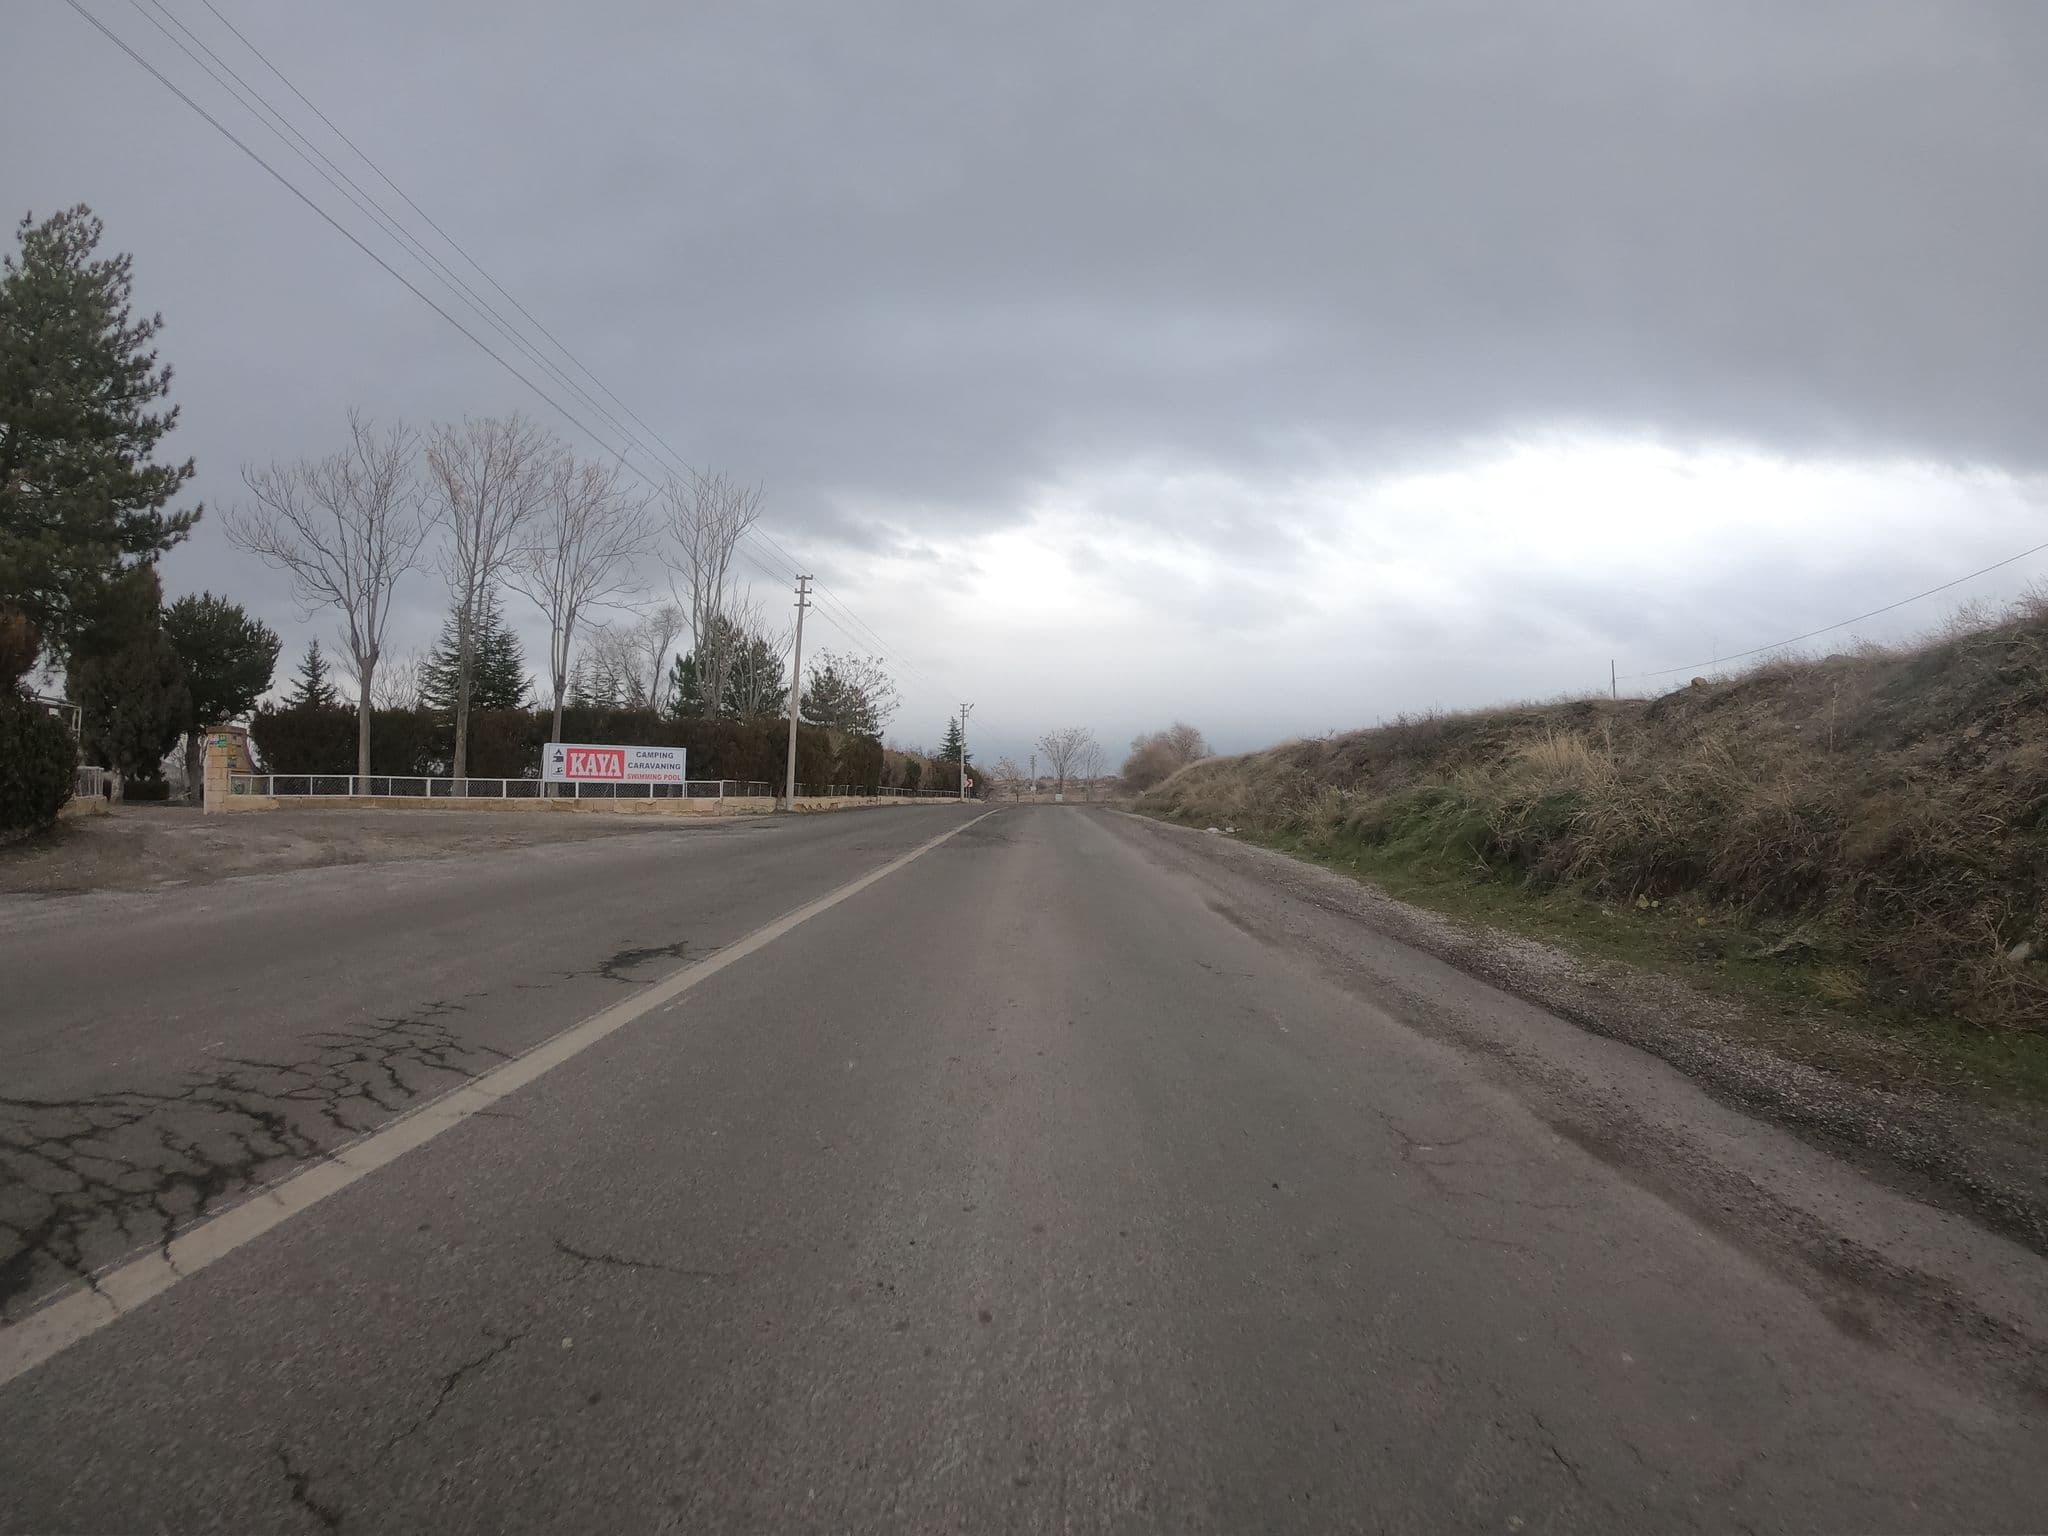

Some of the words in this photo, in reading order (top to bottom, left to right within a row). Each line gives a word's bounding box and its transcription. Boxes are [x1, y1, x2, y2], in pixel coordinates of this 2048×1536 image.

[636, 751, 674, 759] CAMPING
[569, 752, 622, 777] KAYA
[627, 762, 681, 770] CARAVANING
[627, 773, 662, 781] SWIMMING
